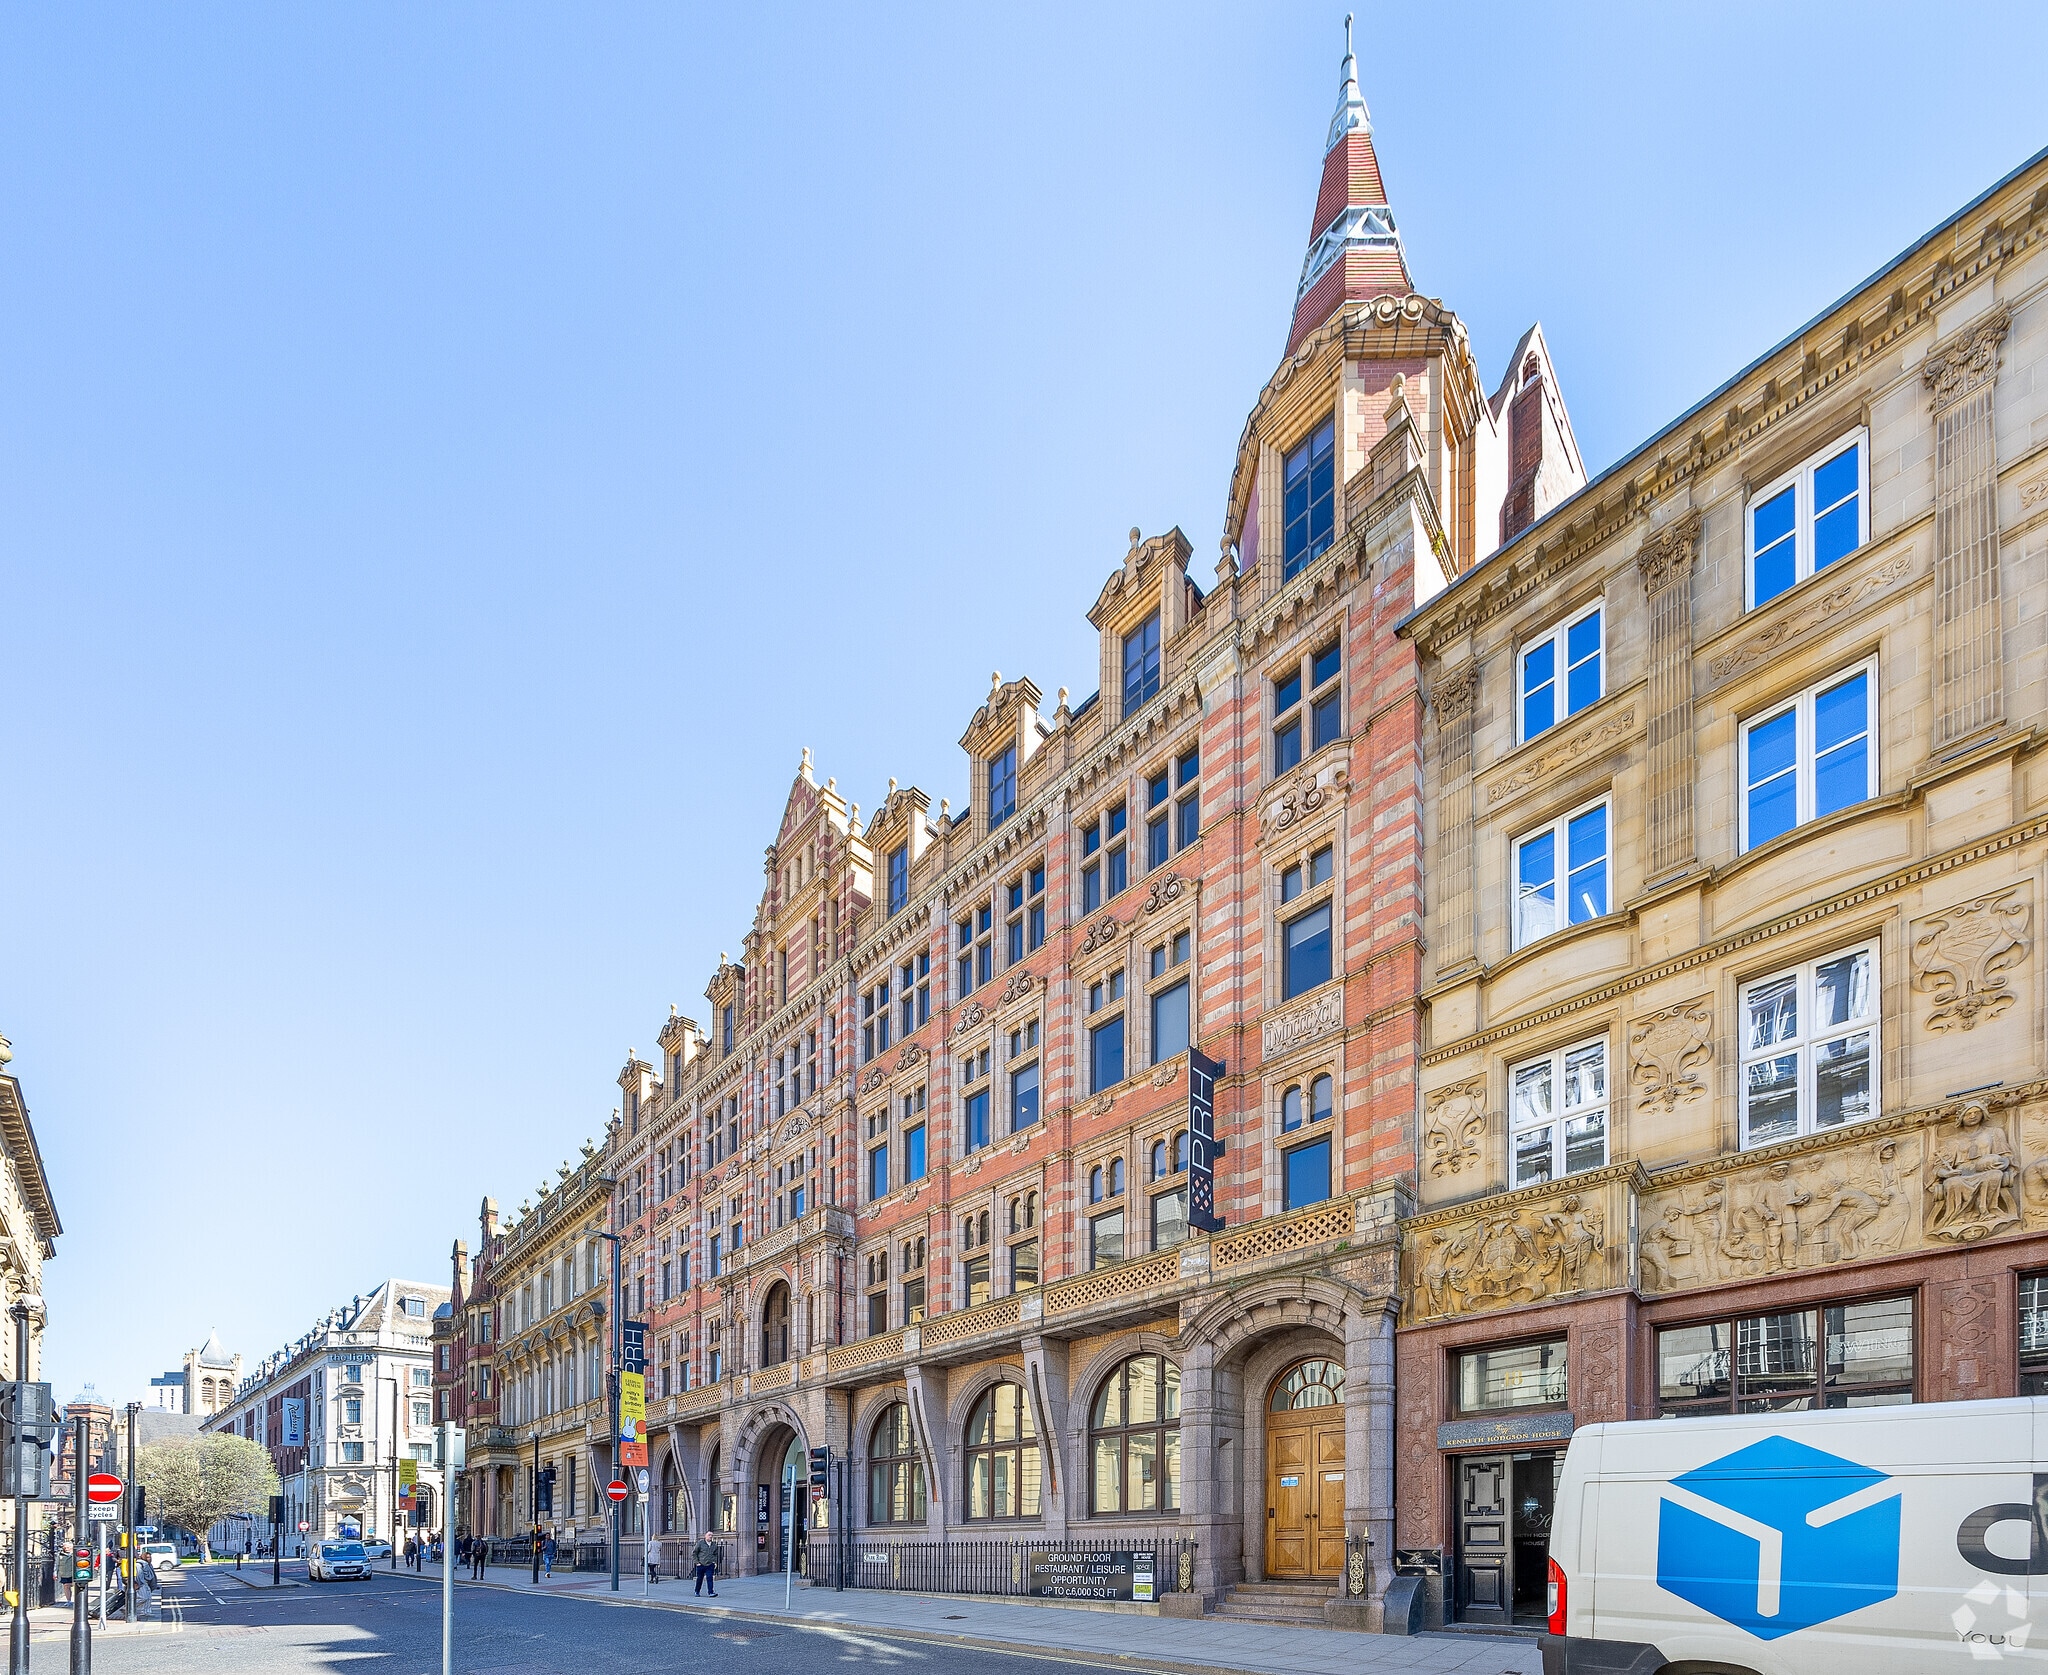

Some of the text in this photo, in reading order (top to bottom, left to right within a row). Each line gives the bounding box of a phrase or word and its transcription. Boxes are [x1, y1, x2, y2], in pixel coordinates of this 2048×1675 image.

[1192, 1067, 1213, 1173] PRH
[1505, 1370, 1523, 1387] 18
[1446, 1430, 1562, 1446] KENNETH HODGSON HOUSE
[89, 1505, 115, 1513] Except
[1047, 1554, 1111, 1562] GROUND FLOOR
[1035, 1564, 1126, 1575] RESTAURANT / LEISURE
[1051, 1575, 1107, 1585] OPPORTUNITY
[1042, 1586, 1117, 1598] UP TO c.6,000 SQ FT
